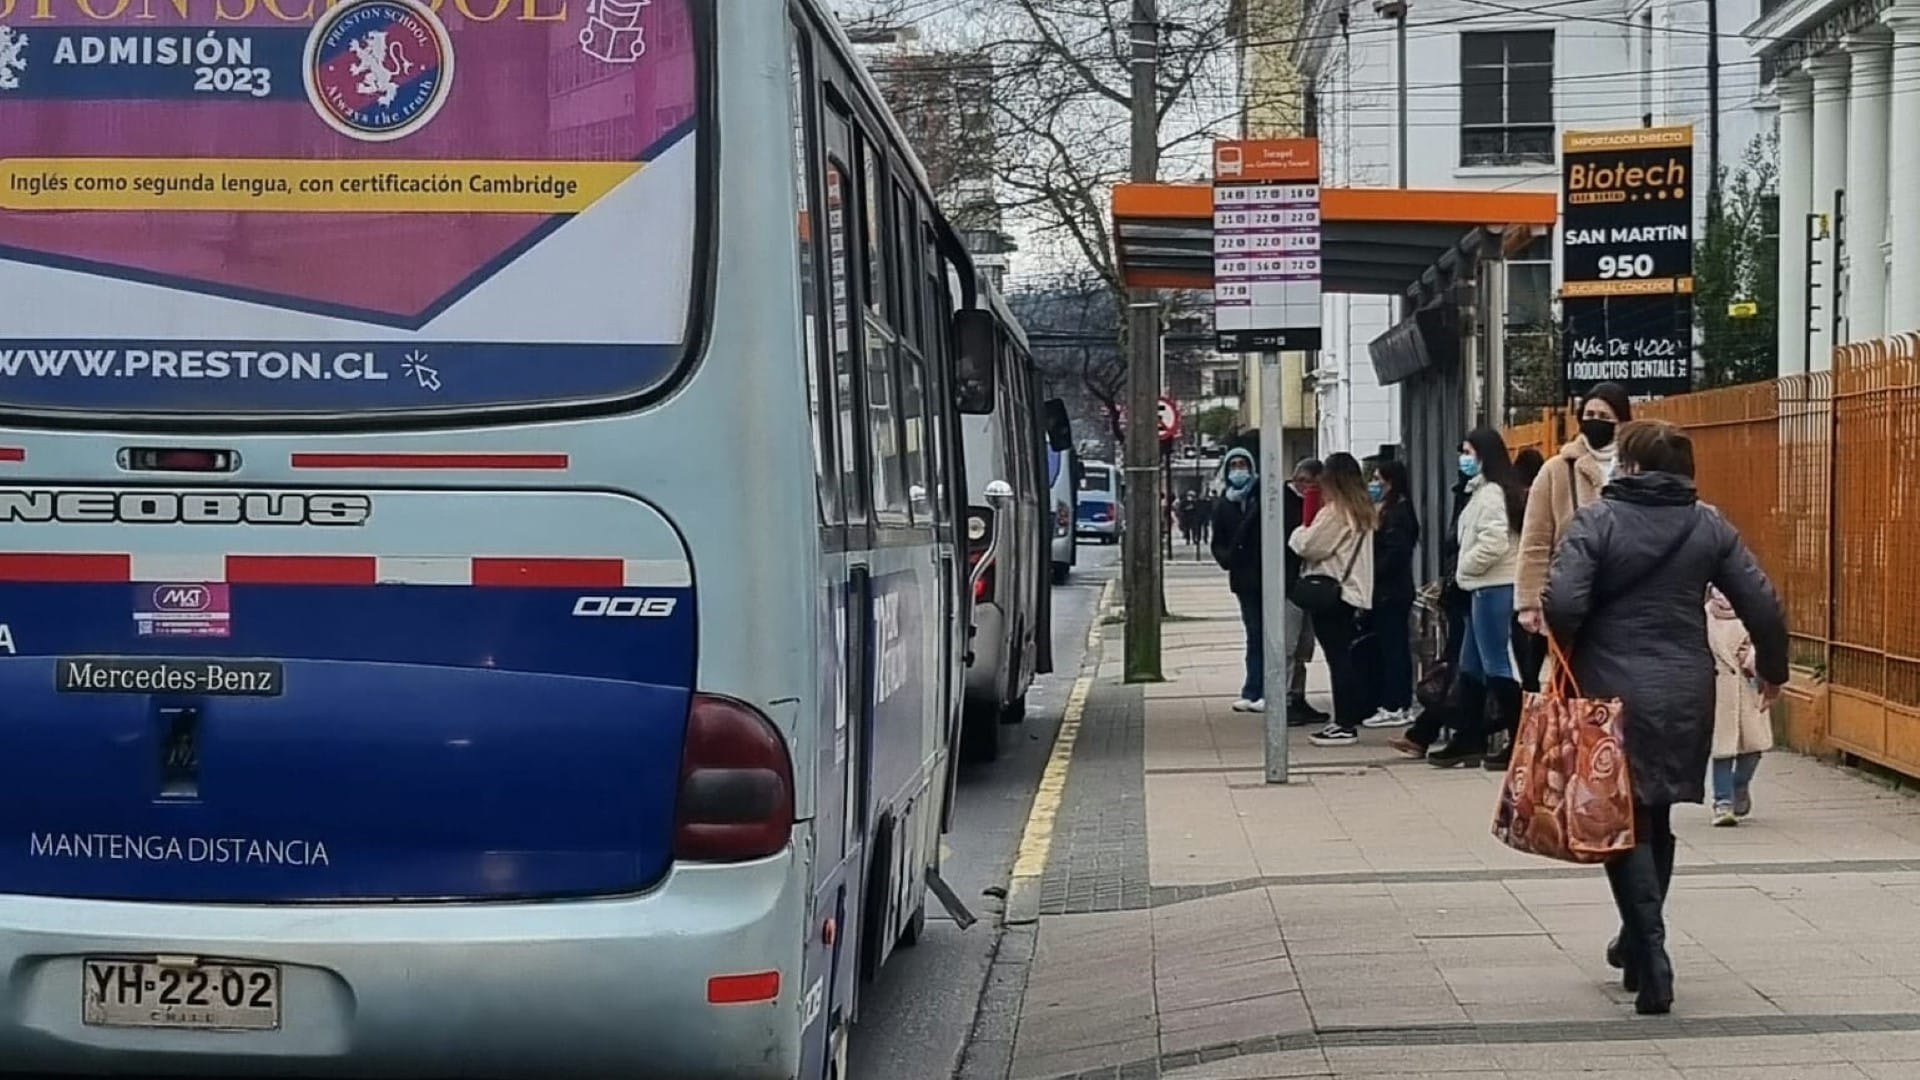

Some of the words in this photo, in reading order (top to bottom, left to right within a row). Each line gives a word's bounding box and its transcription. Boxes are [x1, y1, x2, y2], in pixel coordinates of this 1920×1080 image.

[327, 8, 381, 48] PRESTON
[383, 8, 428, 47] SCHOOL
[53, 30, 252, 65] ADMISIÓN
[193, 66, 271, 97] 2023
[374, 111, 400, 124] the
[402, 80, 433, 116] truth
[10, 172, 68, 195] Inglés
[74, 177, 127, 192] como
[133, 173, 215, 196] segunda
[221, 173, 292, 197] lengua,
[299, 177, 334, 193] con
[340, 173, 464, 194] certificación
[469, 174, 578, 199] Cambridge
[1569, 158, 1685, 190] Biotech
[1565, 229, 1605, 245] SAN
[1611, 224, 1687, 242] MARTÍN
[1598, 254, 1654, 279] 950
[1567, 361, 1629, 380] RODUCTOS
[1631, 359, 1687, 379] DENTALE
[0, 491, 372, 527] NEOBUS
[572, 596, 678, 617] 008
[67, 662, 272, 691] Mercedes-Benz
[30, 831, 184, 861] MANTENGA
[188, 837, 329, 867] DISTANCIA
